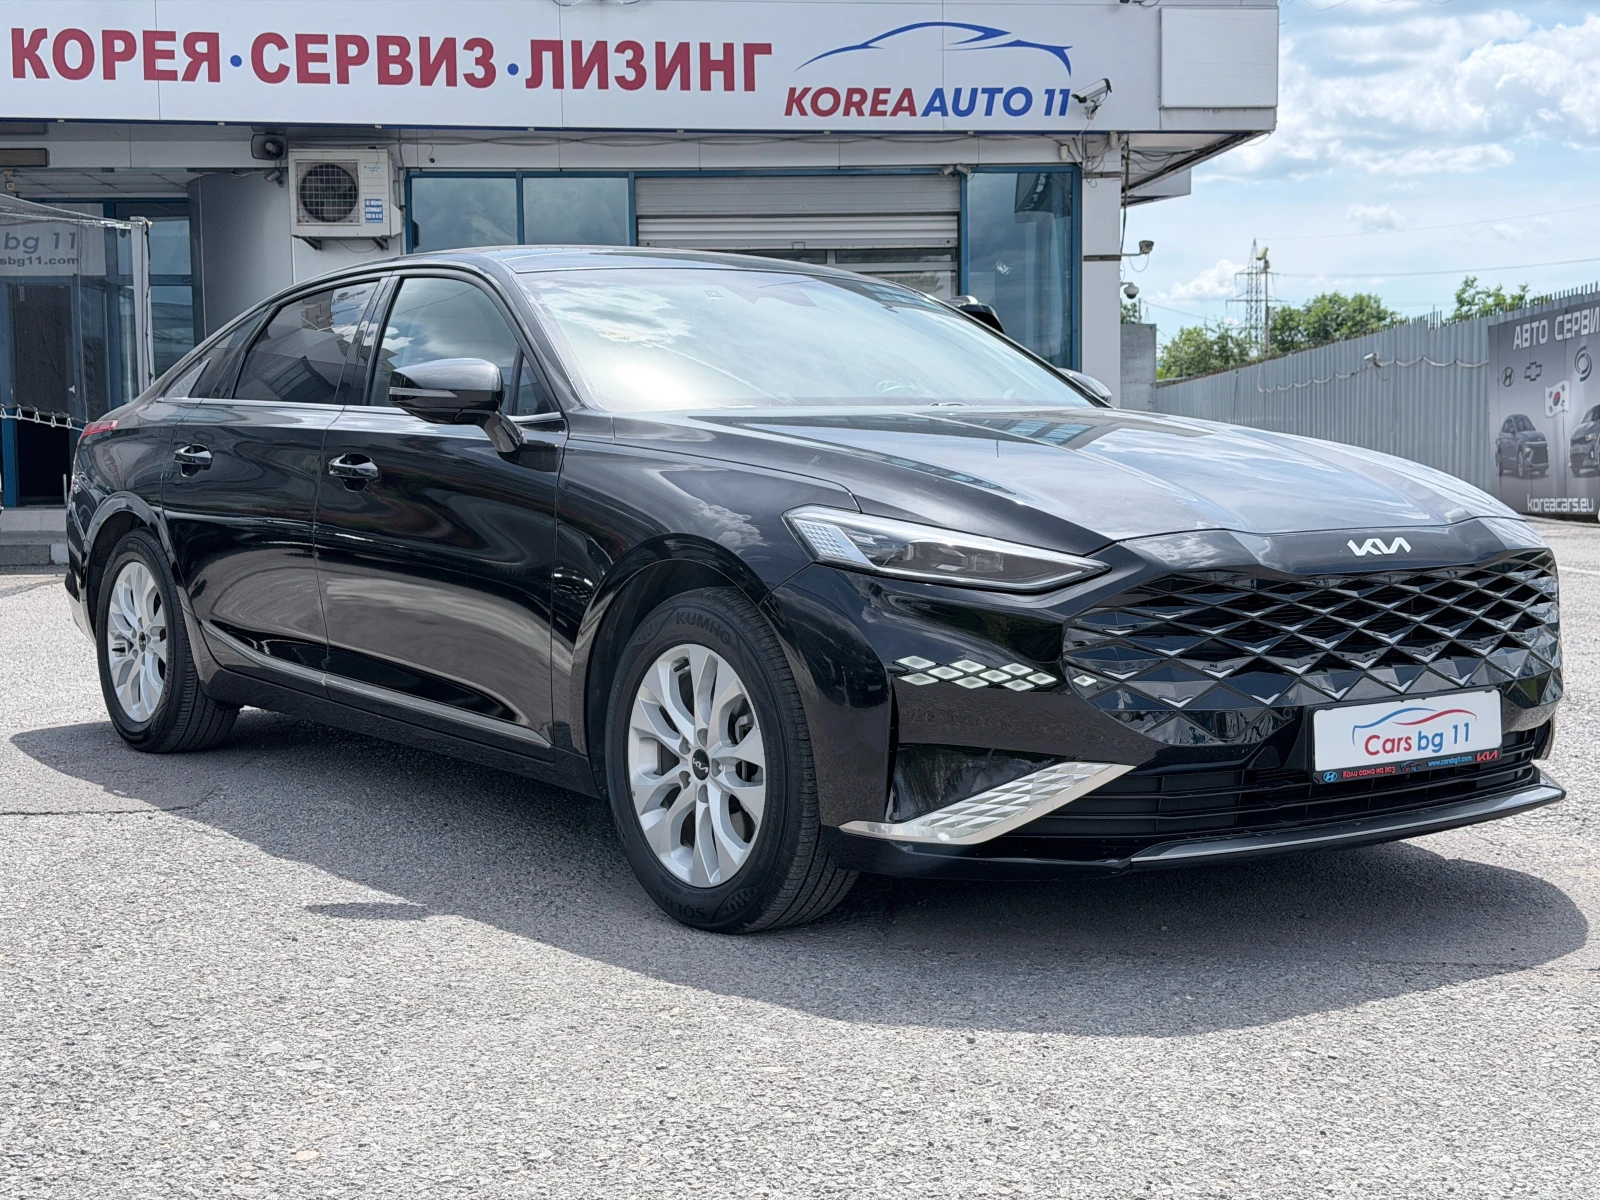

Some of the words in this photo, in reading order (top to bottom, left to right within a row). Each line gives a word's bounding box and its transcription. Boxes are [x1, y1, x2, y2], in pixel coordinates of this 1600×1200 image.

[11, 28, 221, 82] КОРЕЯ
[250, 32, 497, 89] СЕРВИЗ
[525, 39, 773, 92] ЛИЗИНГ
[1043, 88, 1070, 117] 11
[4, 232, 40, 254] bg
[53, 232, 76, 249] 11
[1513, 319, 1548, 350] АВТО
[1555, 306, 1600, 341] СЕРВИ
[1526, 494, 1594, 513] koreacars.eu
[676, 611, 731, 645] KUMHO
[1364, 734, 1412, 756] Cars
[1417, 730, 1444, 753] bg
[1452, 722, 1469, 745] 11
